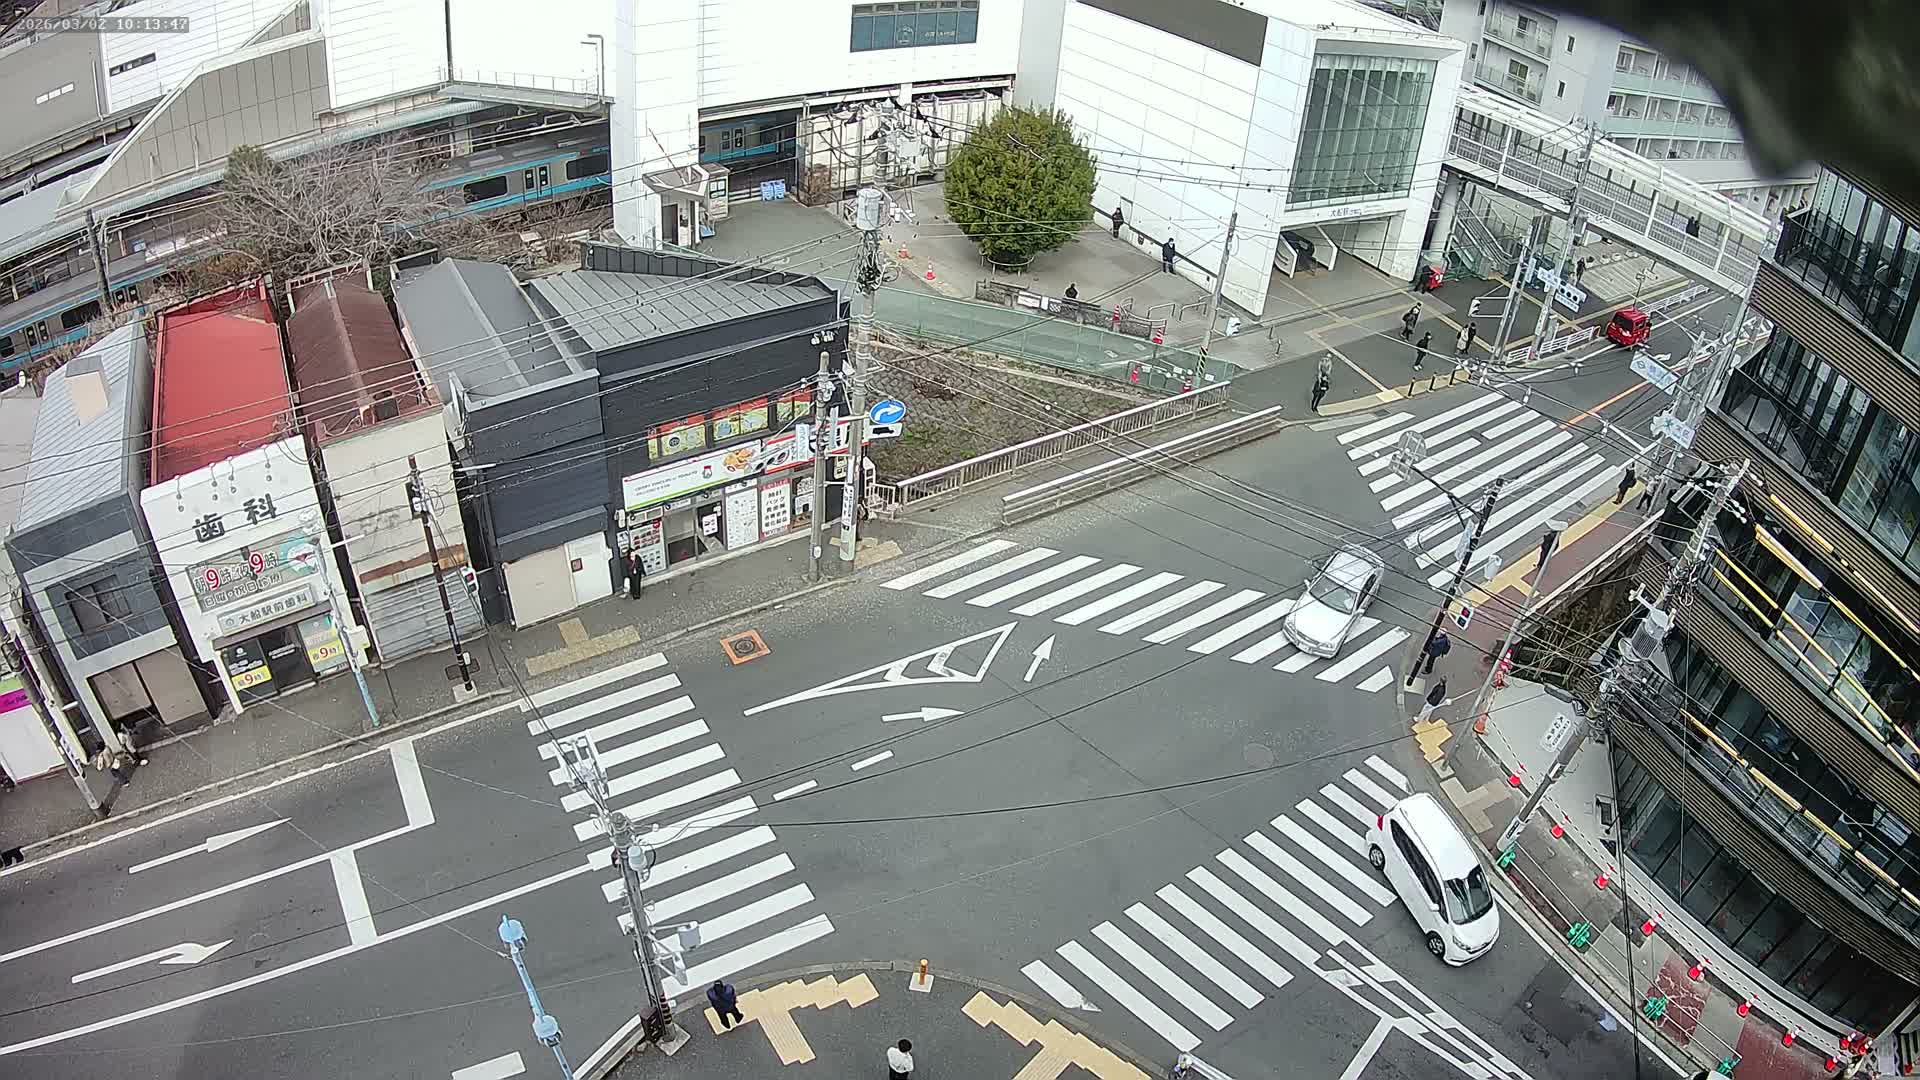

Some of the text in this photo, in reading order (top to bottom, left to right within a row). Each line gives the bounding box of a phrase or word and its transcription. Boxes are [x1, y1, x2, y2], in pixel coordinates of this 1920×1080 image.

[192, 493, 278, 542] 歯科
[239, 593, 309, 626] 大船駅前歯科
